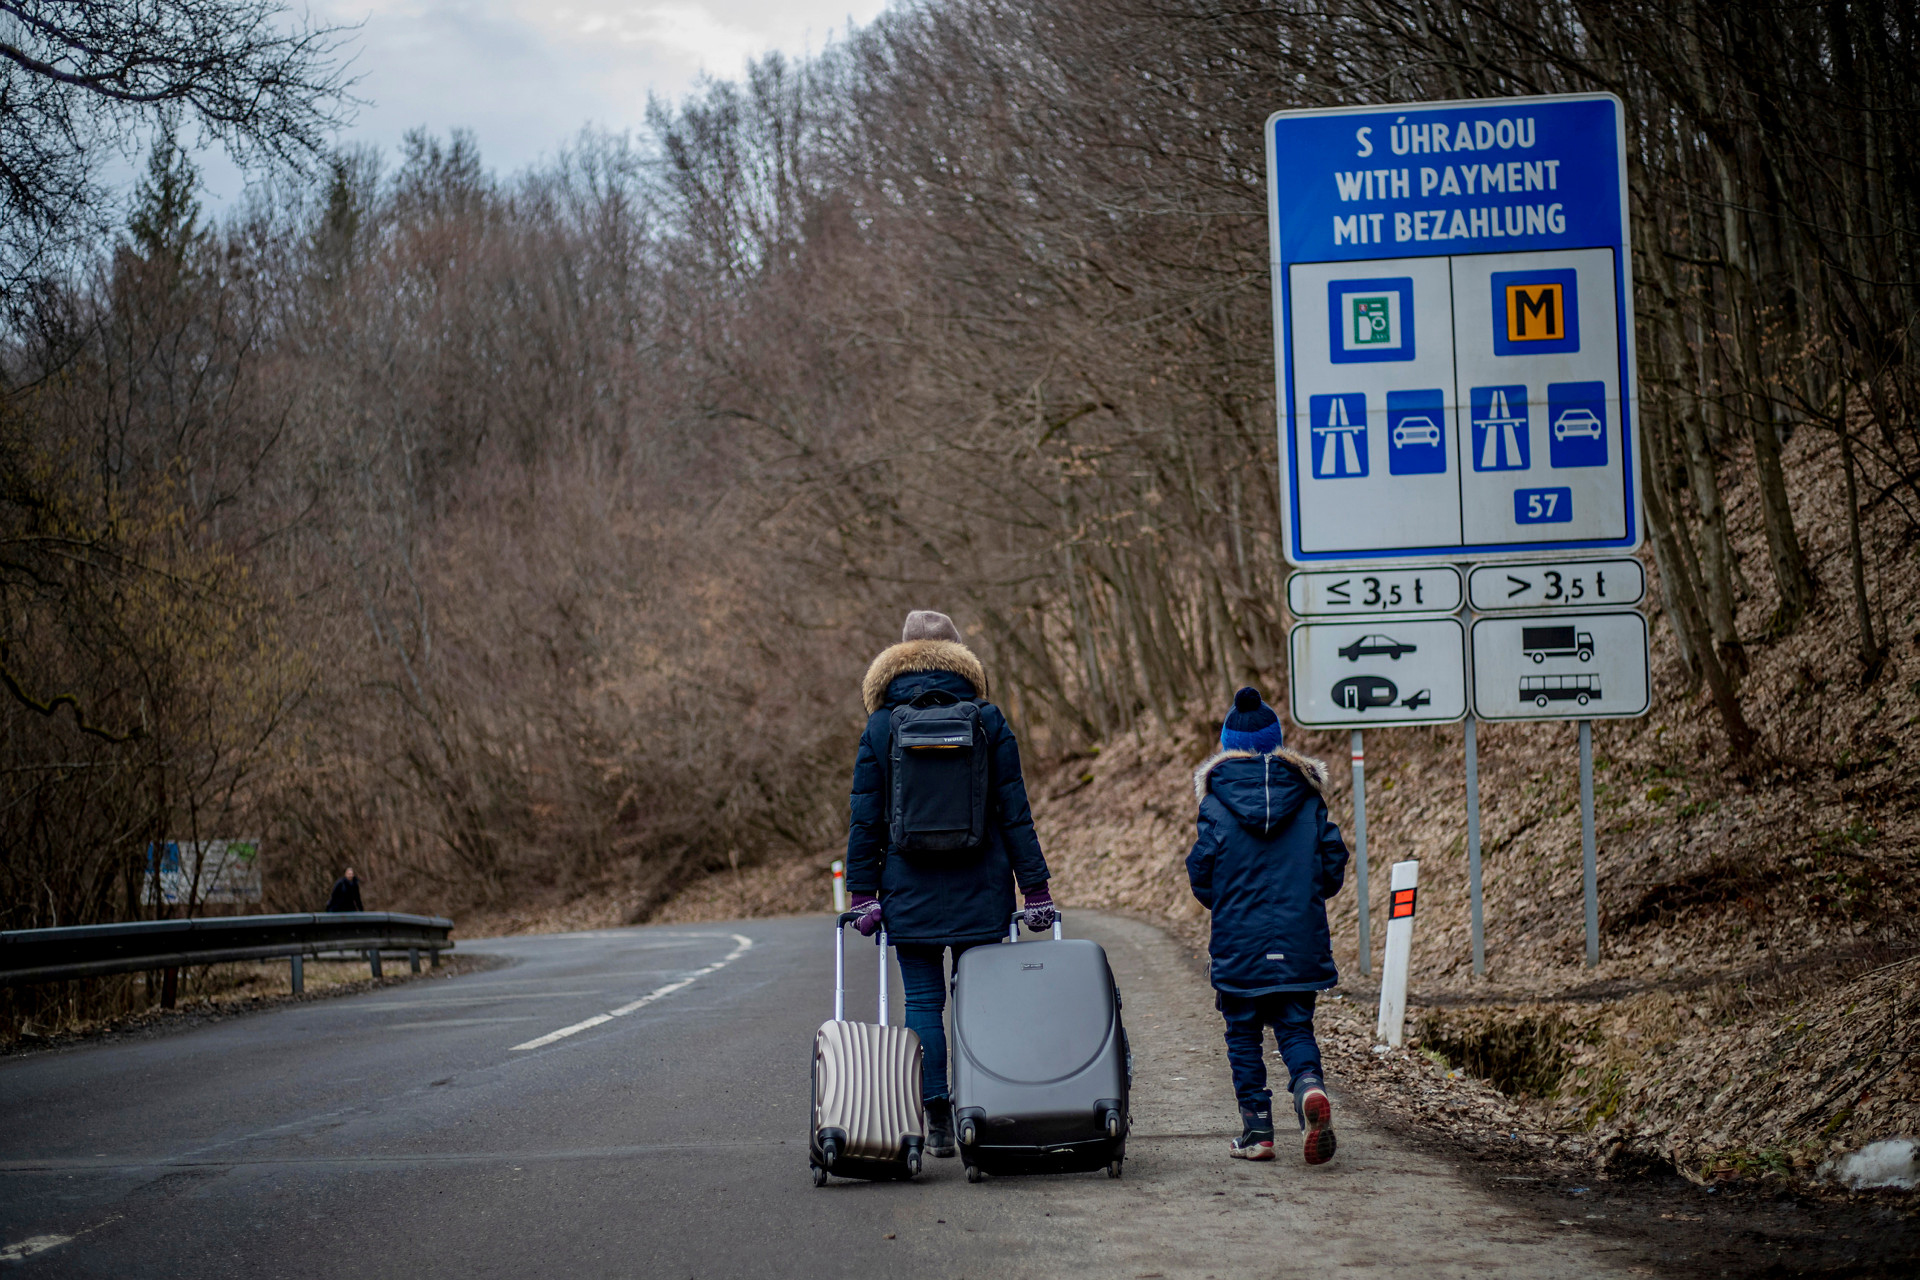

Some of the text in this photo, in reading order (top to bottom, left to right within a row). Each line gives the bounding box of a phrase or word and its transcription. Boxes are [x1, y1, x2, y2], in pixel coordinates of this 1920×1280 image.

[1356, 116, 1536, 158] S ÚHRADOU
[1334, 160, 1560, 202] WITH PAYMENT
[1333, 203, 1566, 246] MIT BEZAHLUNG
[1514, 288, 1556, 337] M
[1527, 493, 1559, 518] 57
[1414, 578, 1424, 605] t
[1596, 570, 1606, 598] t
